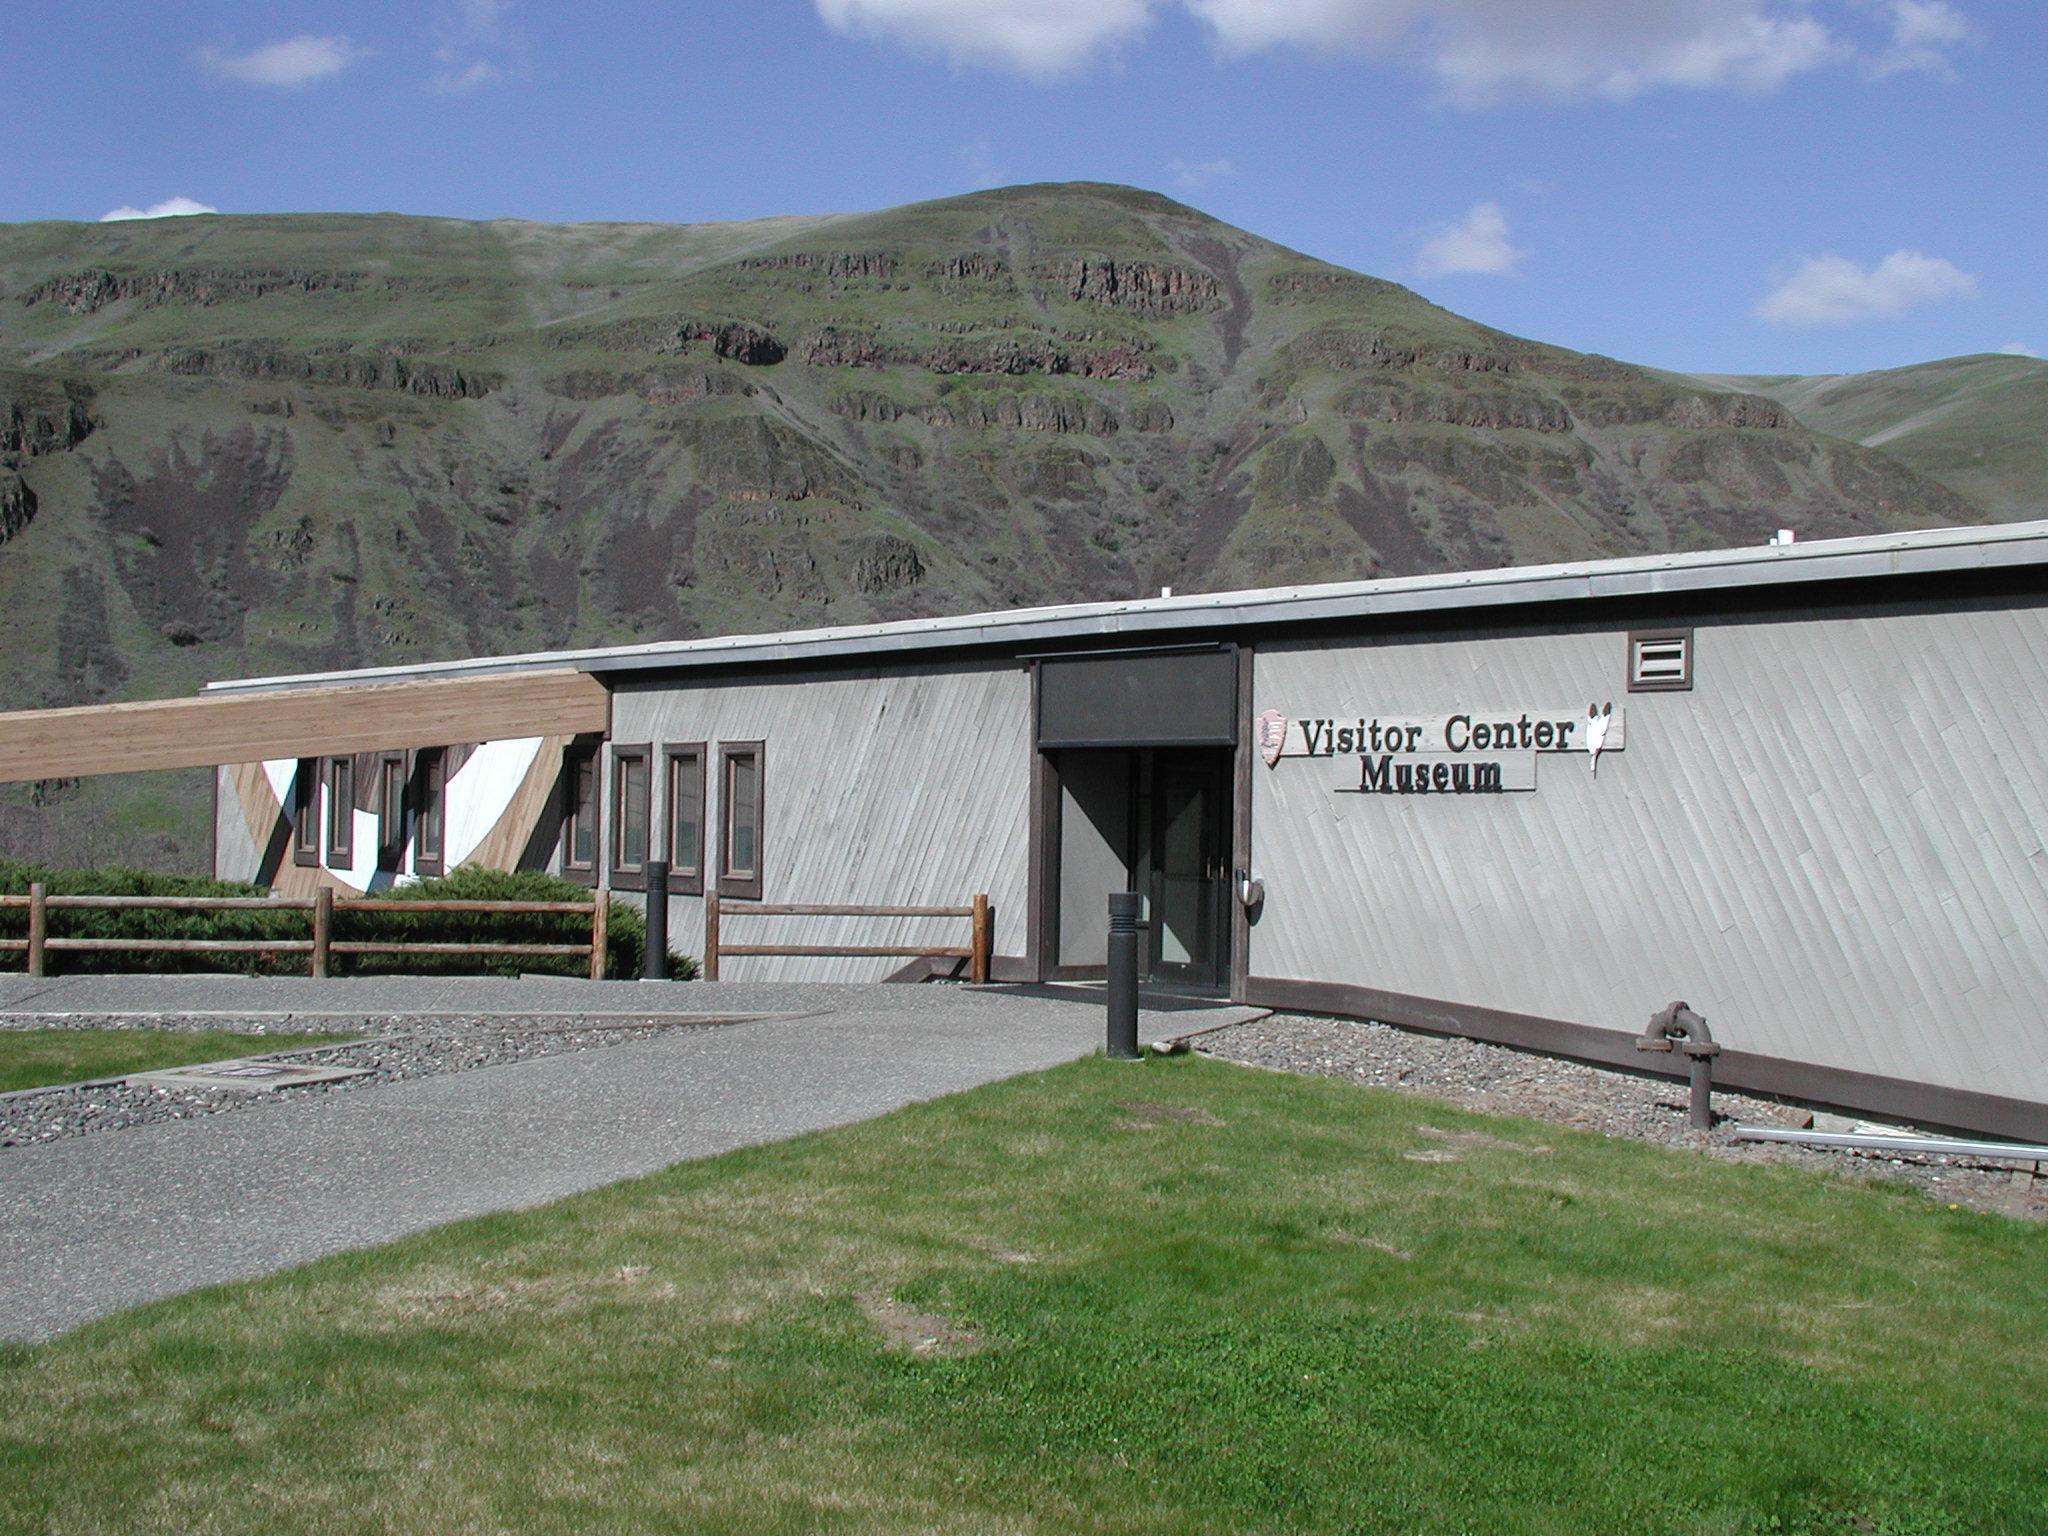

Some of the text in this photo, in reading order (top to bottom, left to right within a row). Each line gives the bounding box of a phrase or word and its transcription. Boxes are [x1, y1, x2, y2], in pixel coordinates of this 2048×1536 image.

[1298, 718, 1422, 757] Visitor
[1445, 714, 1574, 752] Center
[1359, 754, 1502, 794] Museum
